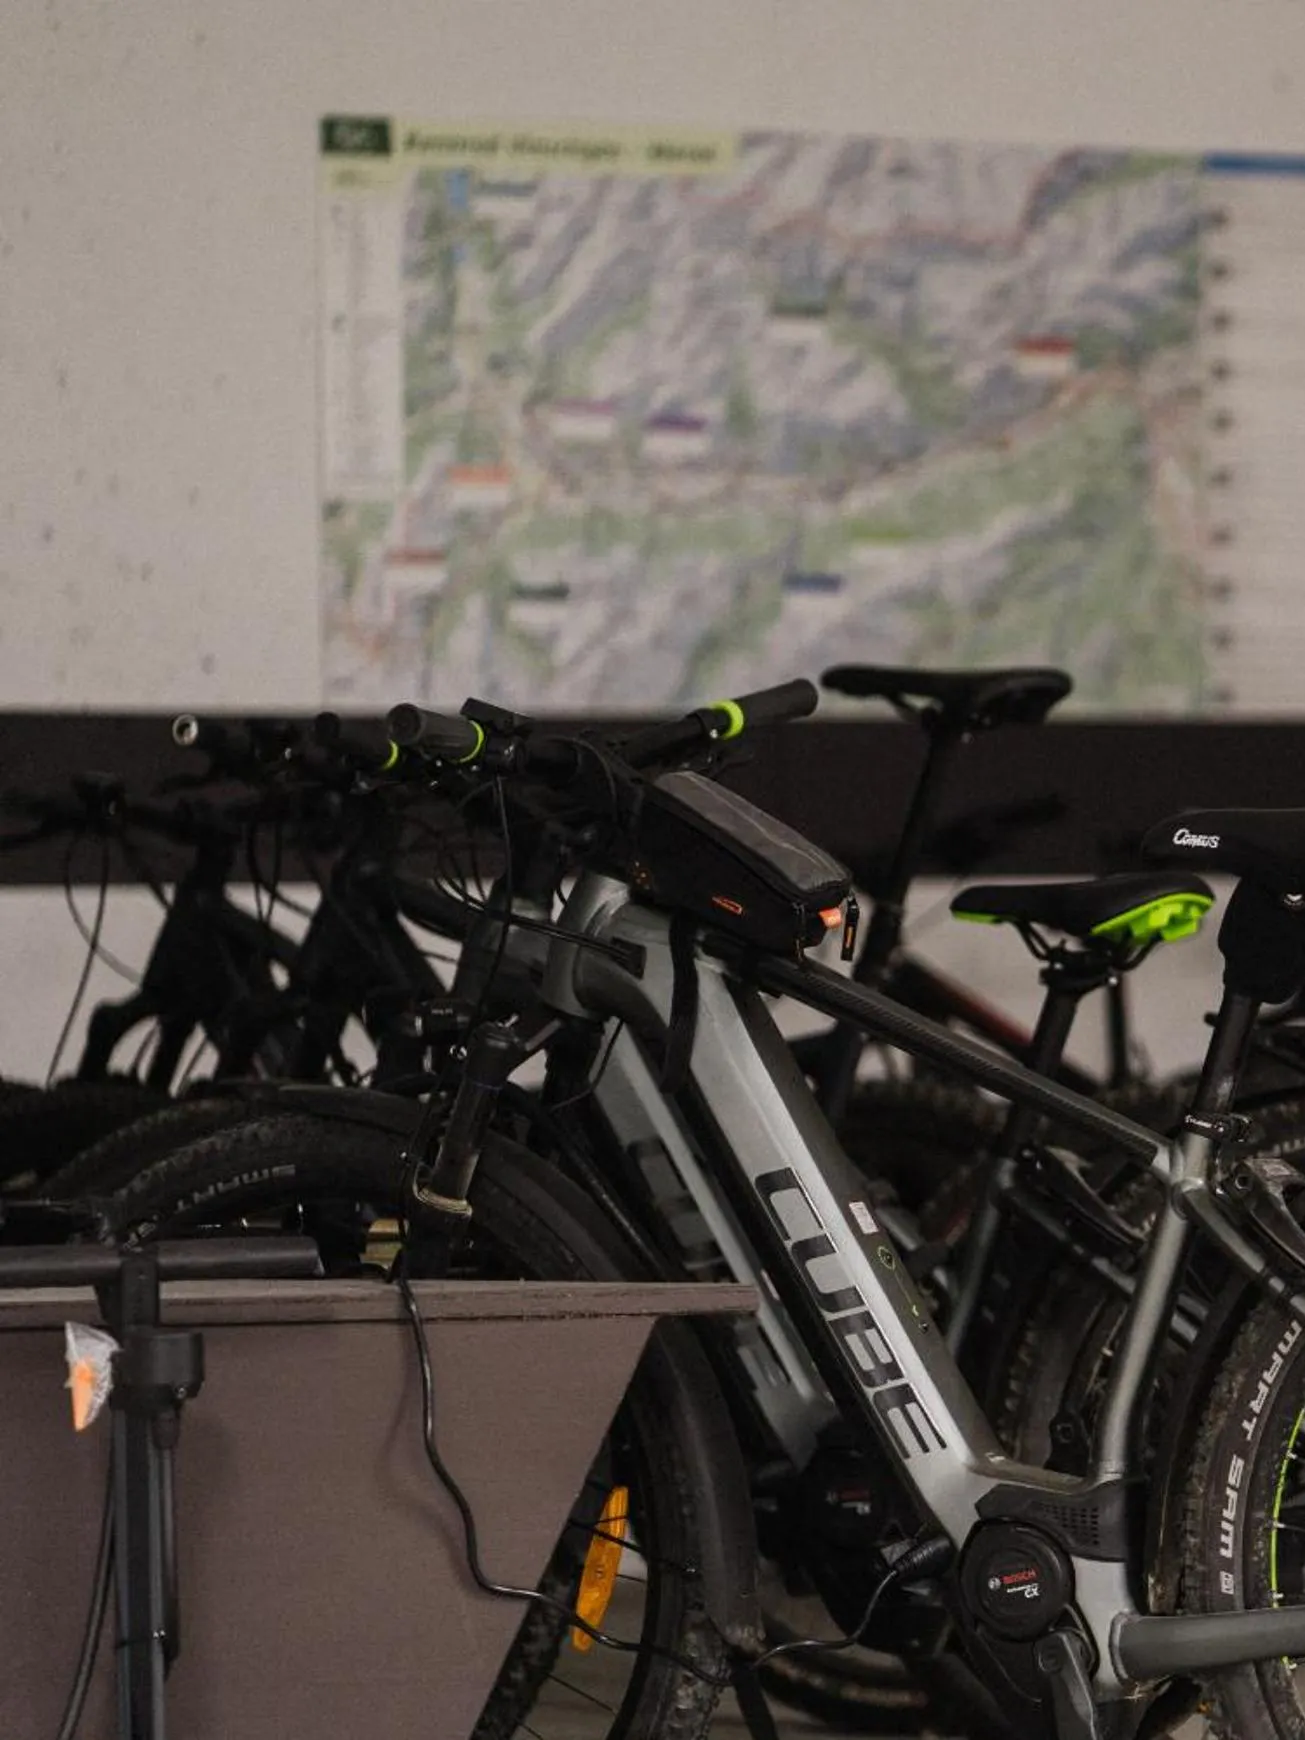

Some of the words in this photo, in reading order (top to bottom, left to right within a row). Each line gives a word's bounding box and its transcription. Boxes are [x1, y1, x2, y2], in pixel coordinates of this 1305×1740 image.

[754, 1166, 947, 1460] CUBE
[1241, 1318, 1304, 1442] MART
[1218, 1452, 1246, 1560] SAM
